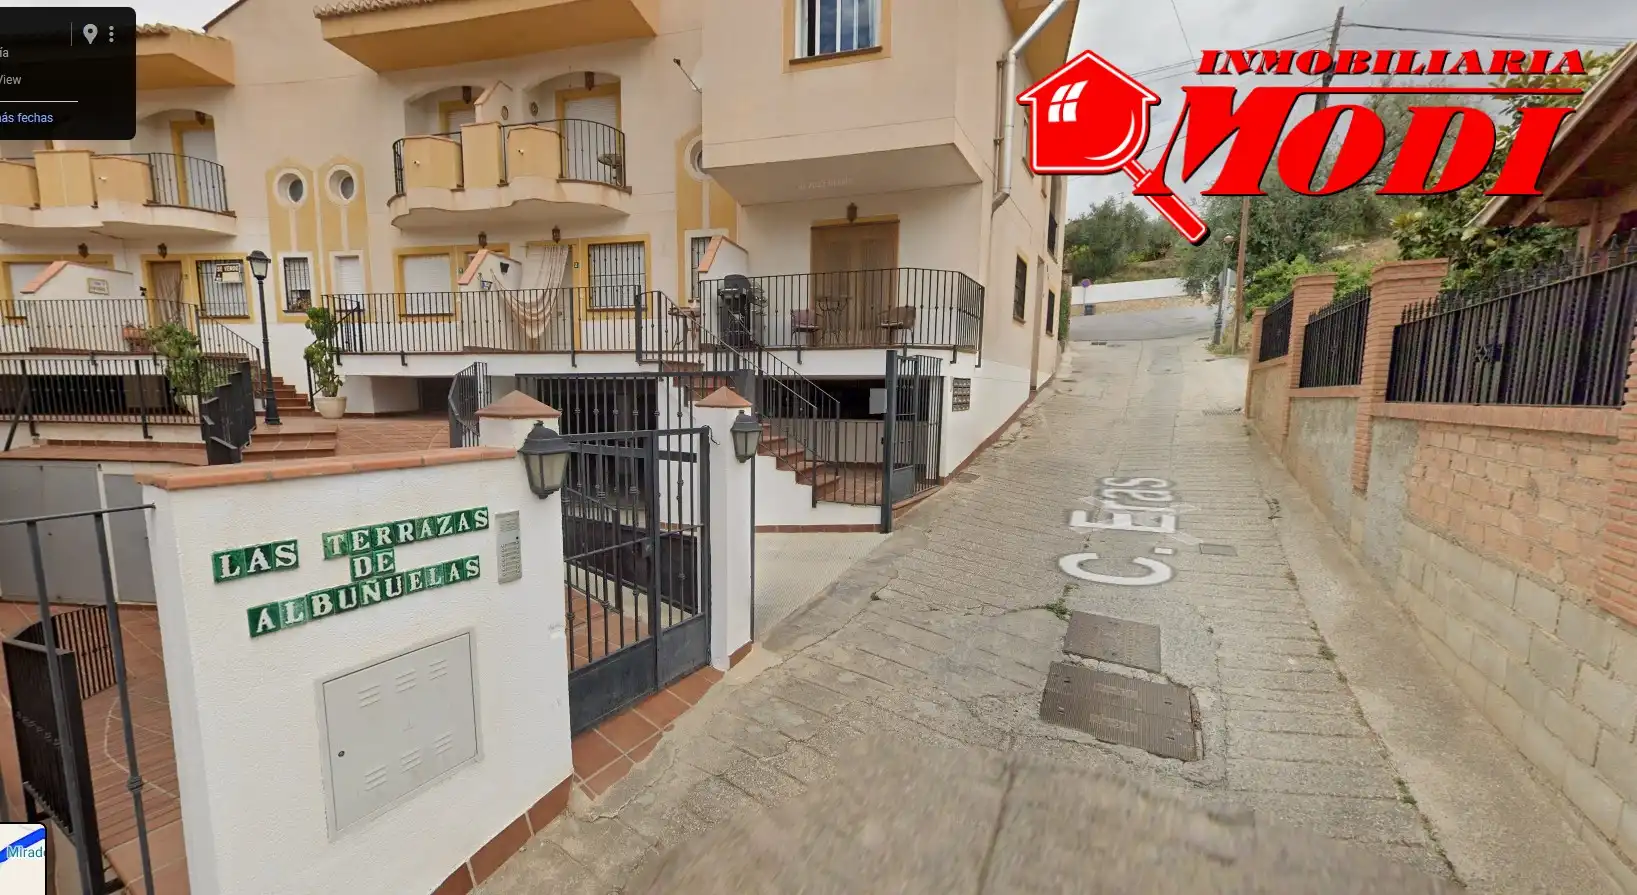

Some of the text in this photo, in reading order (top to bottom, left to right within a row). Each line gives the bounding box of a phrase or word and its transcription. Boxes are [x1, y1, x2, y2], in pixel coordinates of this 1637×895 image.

[219, 509, 489, 580] LAS TERRAZAS
[352, 550, 396, 579] DE
[256, 558, 480, 634] ALBUÑUELAS
